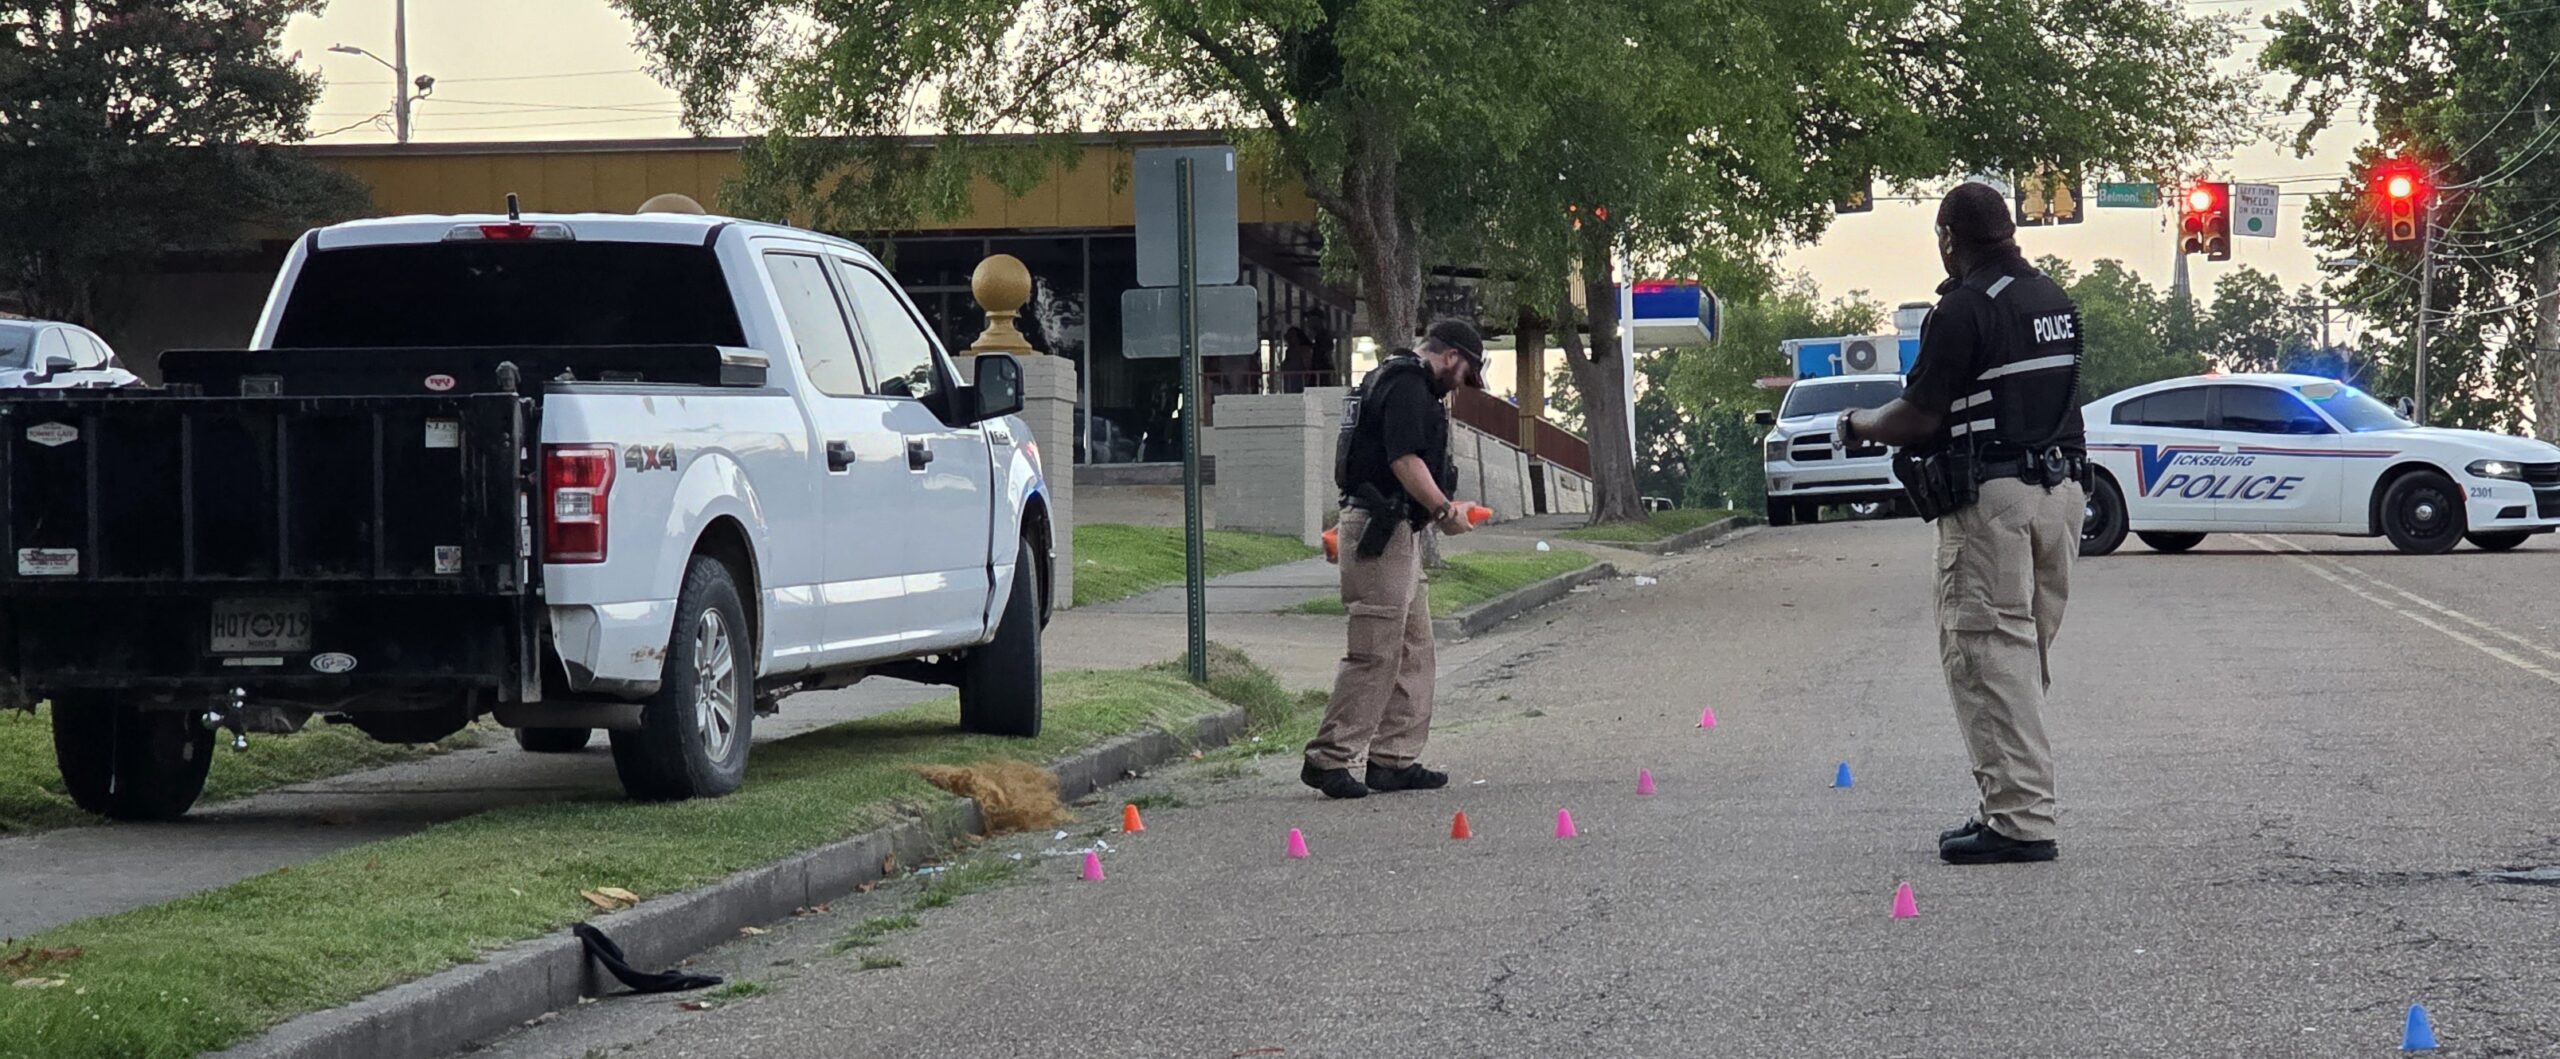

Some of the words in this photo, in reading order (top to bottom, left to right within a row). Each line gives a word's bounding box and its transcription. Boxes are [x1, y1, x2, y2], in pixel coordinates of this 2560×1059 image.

[2033, 313, 2075, 343] POLICE
[2152, 474, 2305, 500] POLICE
[2470, 487, 2492, 498] 2301
